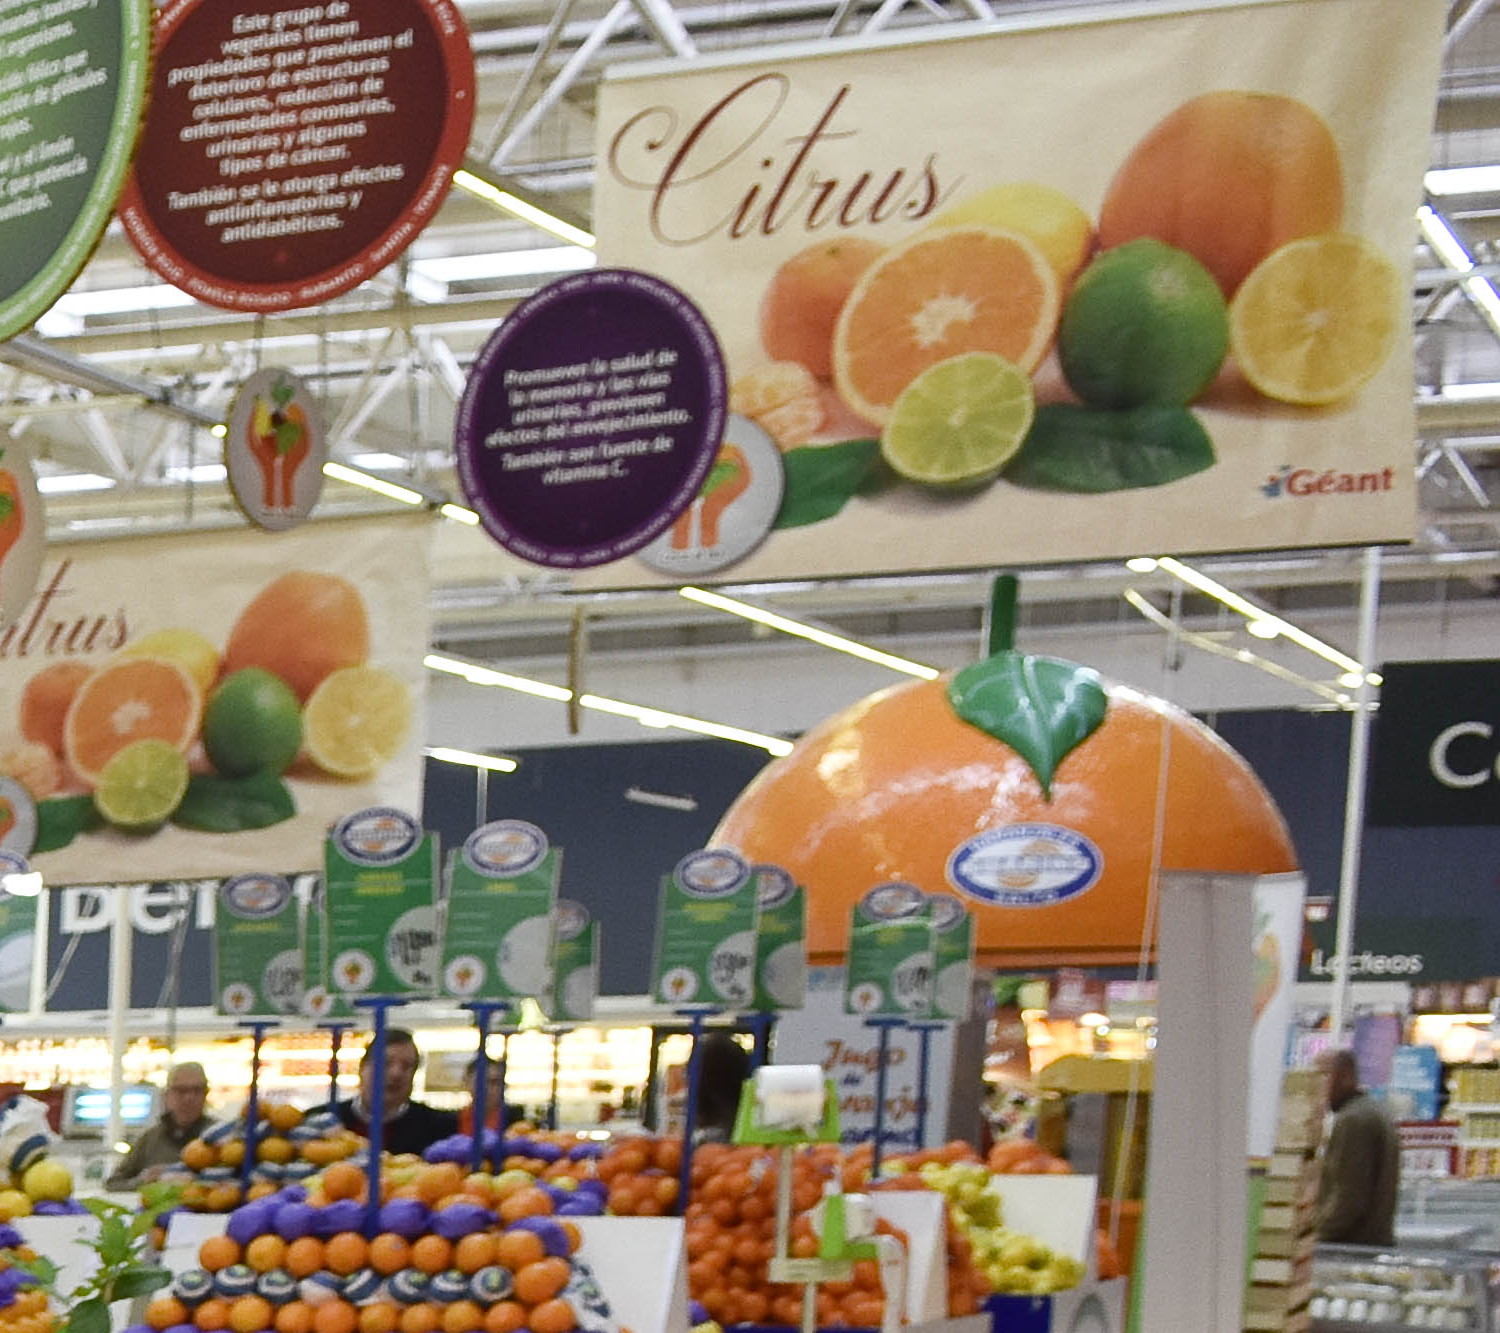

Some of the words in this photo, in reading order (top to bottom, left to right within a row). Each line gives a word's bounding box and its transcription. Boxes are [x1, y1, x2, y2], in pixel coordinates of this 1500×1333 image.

[232, 13, 270, 34] Este
[272, 5, 324, 31] grupo
[326, 1, 350, 18] de
[220, 30, 302, 56] vegetales
[304, 21, 359, 42] tienen
[168, 54, 271, 87] propiedades
[273, 49, 306, 68] que
[308, 35, 392, 63] previenen
[394, 28, 413, 49] el
[267, 70, 290, 88] de
[292, 55, 389, 84] estructuras
[361, 76, 384, 95] de
[180, 111, 297, 142] enfermedades
[206, 133, 280, 158] urinarias
[297, 120, 366, 146] algunos
[220, 155, 264, 177] tipos
[265, 150, 289, 169] de
[608, 74, 963, 247] Citrus
[168, 186, 237, 211] También
[239, 184, 261, 200] se
[281, 172, 338, 197] otorga
[341, 163, 404, 186] efectos
[1287, 469, 1394, 498] Géant
